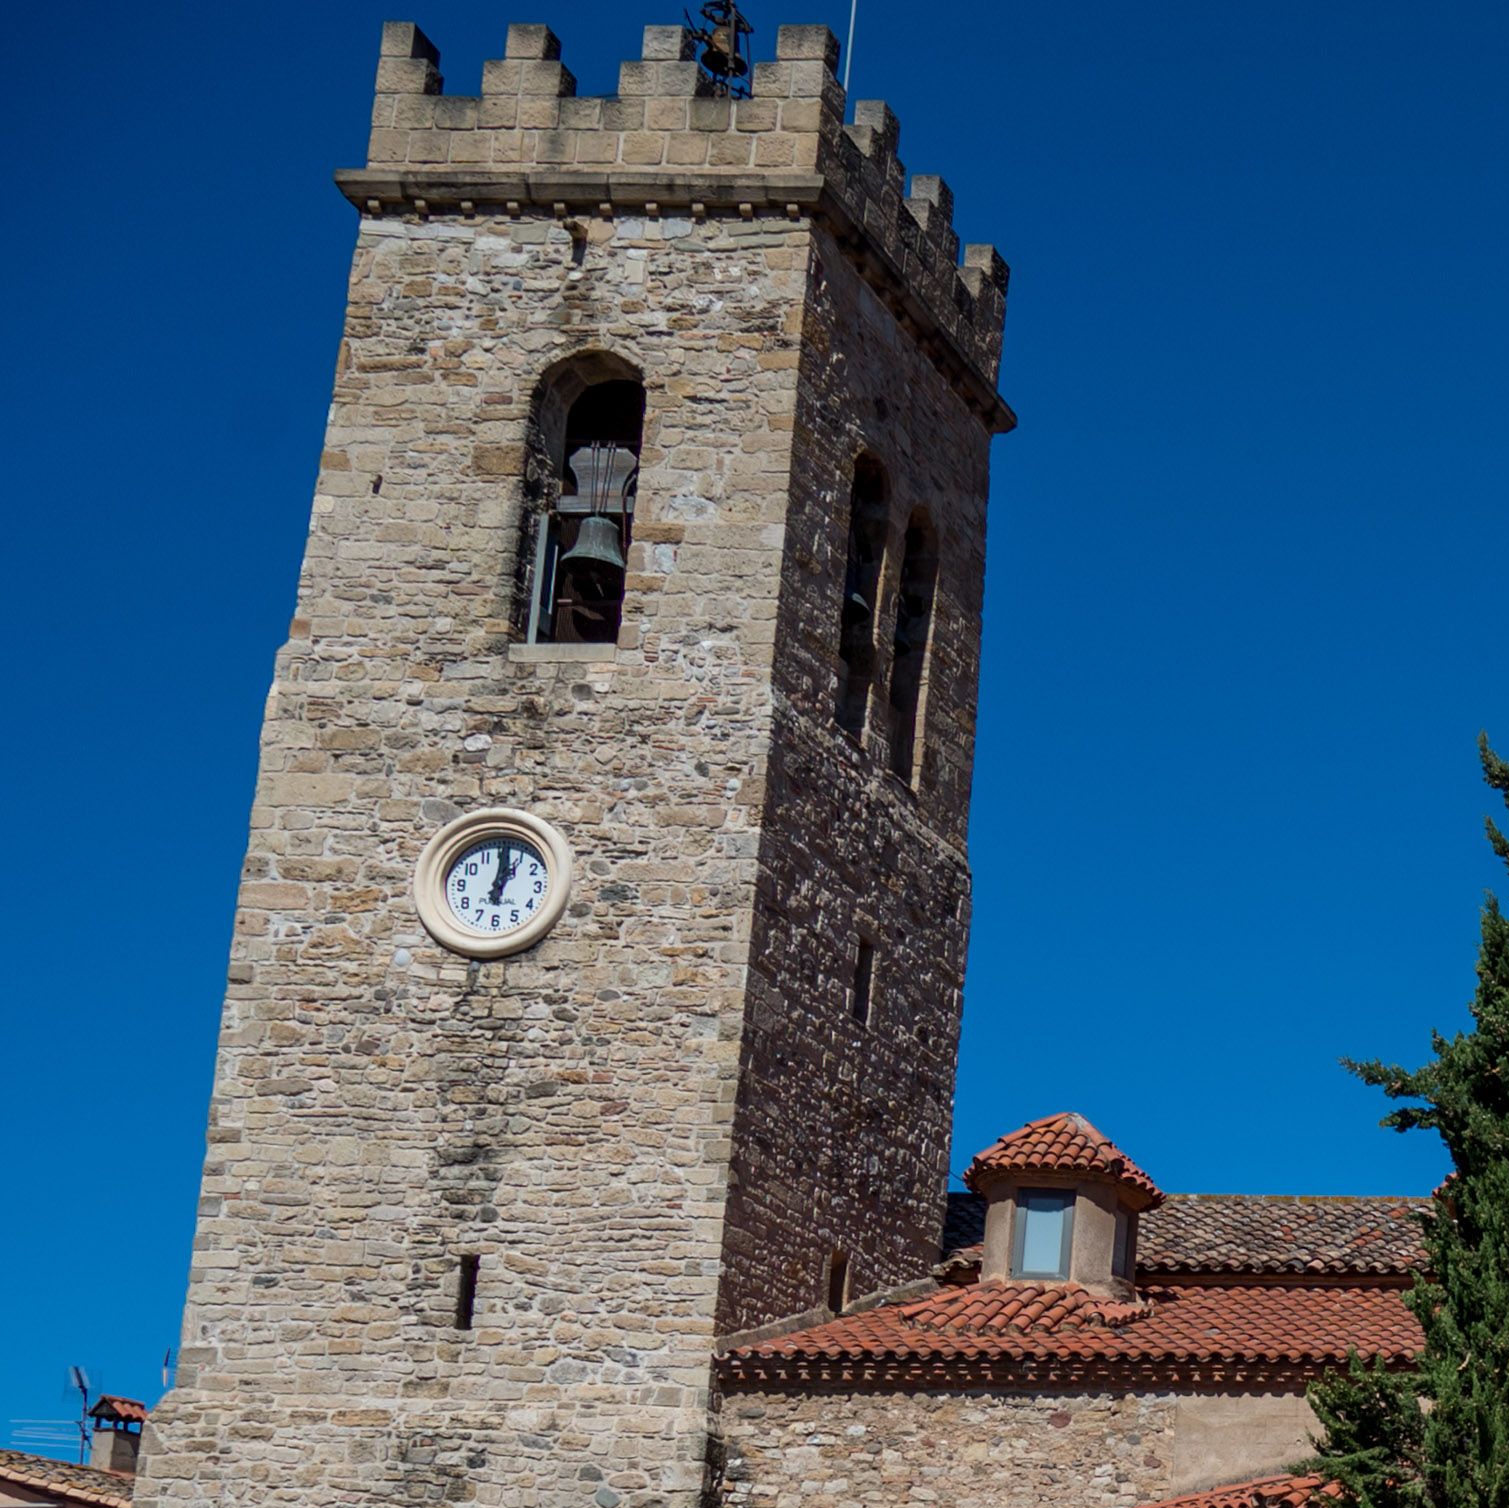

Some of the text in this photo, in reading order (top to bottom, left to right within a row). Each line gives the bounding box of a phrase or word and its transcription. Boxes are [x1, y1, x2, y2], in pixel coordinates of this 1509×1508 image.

[481, 851, 490, 864] 11
[465, 863, 478, 876] 10
[529, 863, 538, 876] 2
[457, 879, 466, 892] 9
[533, 880, 542, 893] 3
[461, 897, 469, 909] 8
[525, 897, 533, 910] 4
[475, 909, 484, 922] 7
[491, 914, 500, 927] 6
[510, 910, 519, 922] 5
